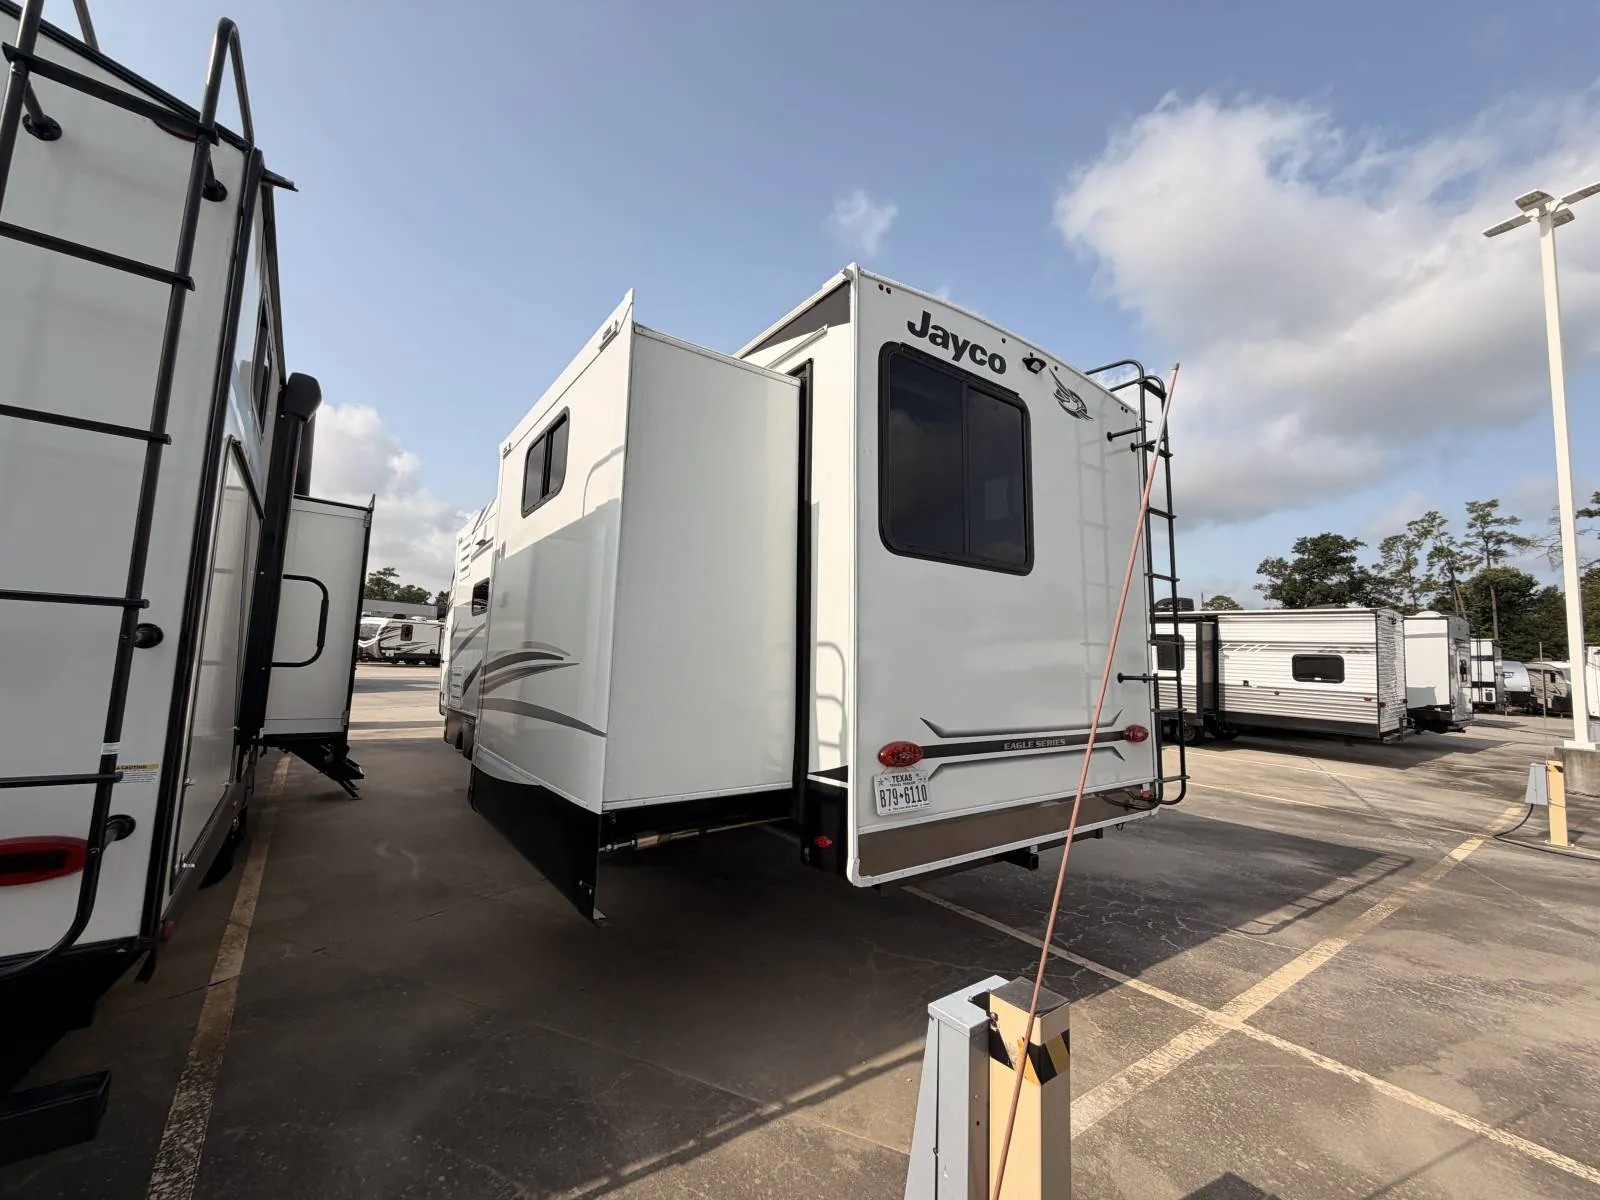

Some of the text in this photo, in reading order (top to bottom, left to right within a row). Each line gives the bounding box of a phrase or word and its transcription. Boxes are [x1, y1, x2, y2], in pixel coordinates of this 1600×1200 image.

[907, 310, 1007, 375] Jayco
[1004, 738, 1066, 750] EAGLE SERIES
[891, 773, 913, 783] TEXAS
